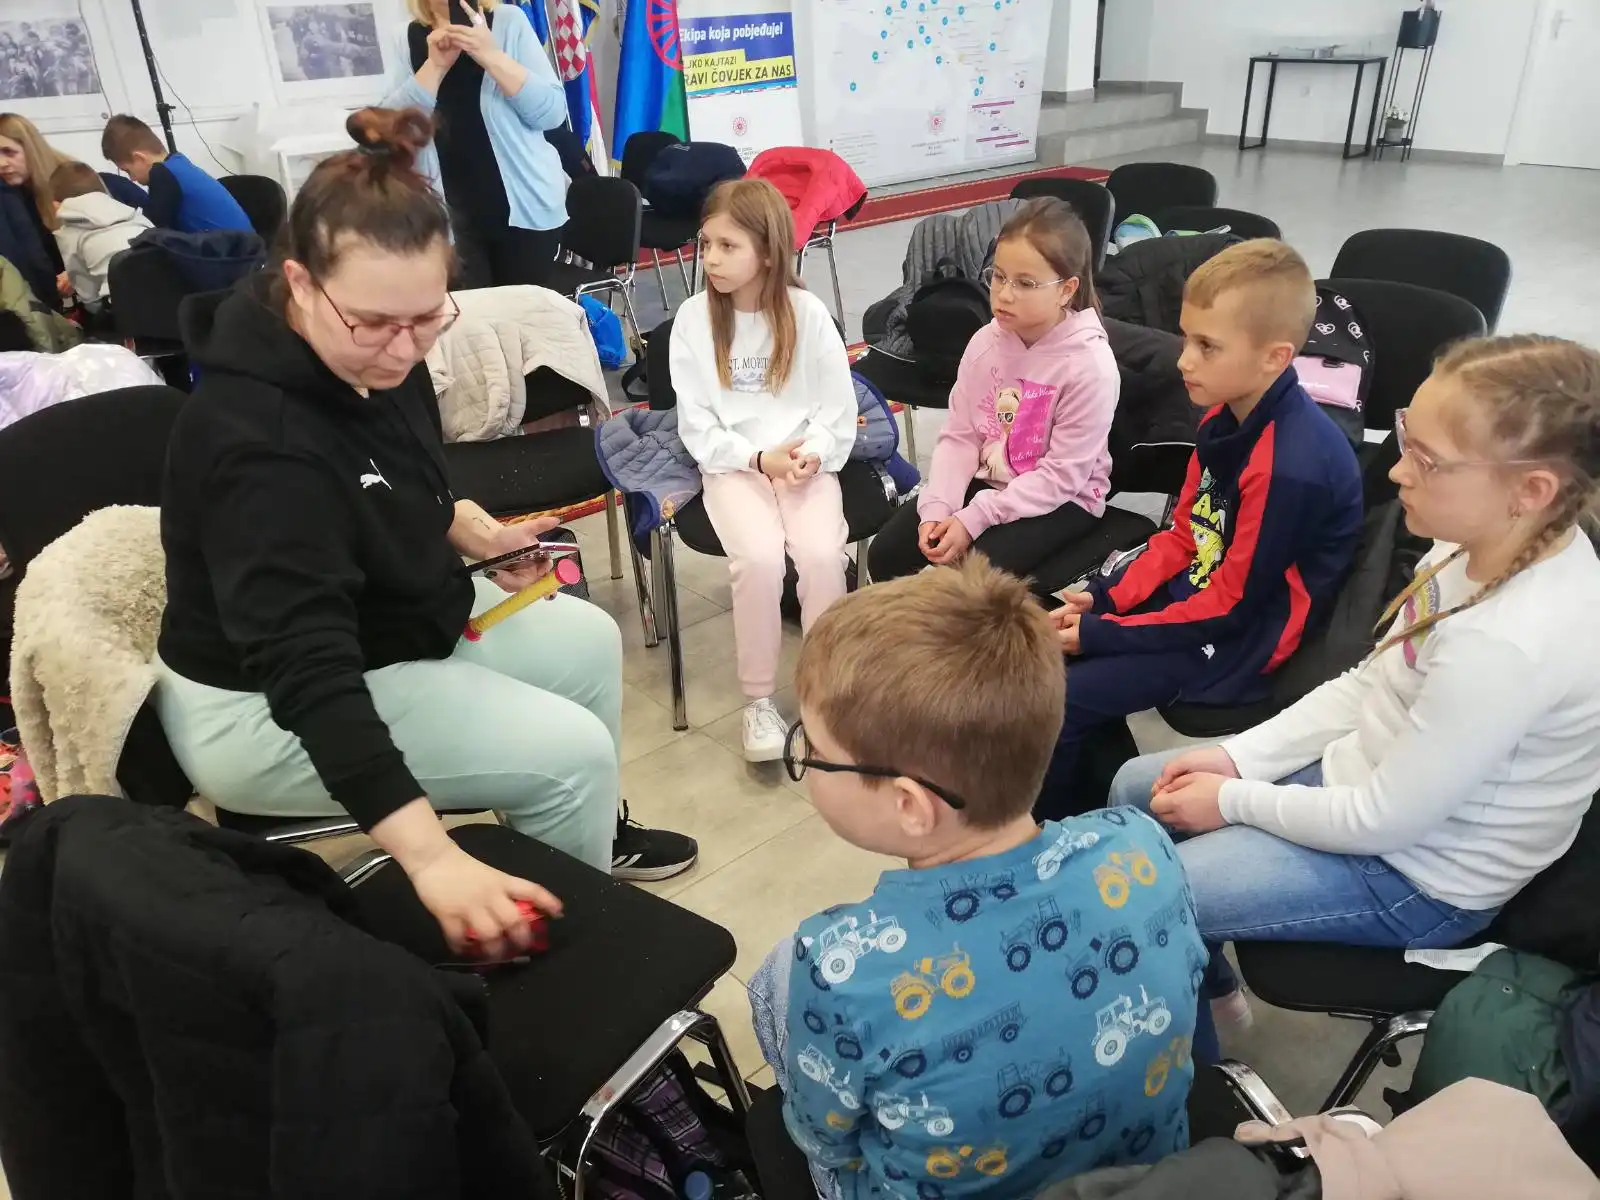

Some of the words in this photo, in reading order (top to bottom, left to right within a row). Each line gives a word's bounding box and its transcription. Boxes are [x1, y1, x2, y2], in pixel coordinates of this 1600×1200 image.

[679, 28, 706, 44] Ekipa
[709, 26, 730, 42] koja
[733, 22, 783, 41] pobjeđuje!
[686, 58, 702, 69] JKO
[704, 56, 737, 68] KAJTAZI
[711, 67, 752, 84] ČOVJEK
[755, 66, 768, 79] ZA
[771, 64, 791, 78] NAS
